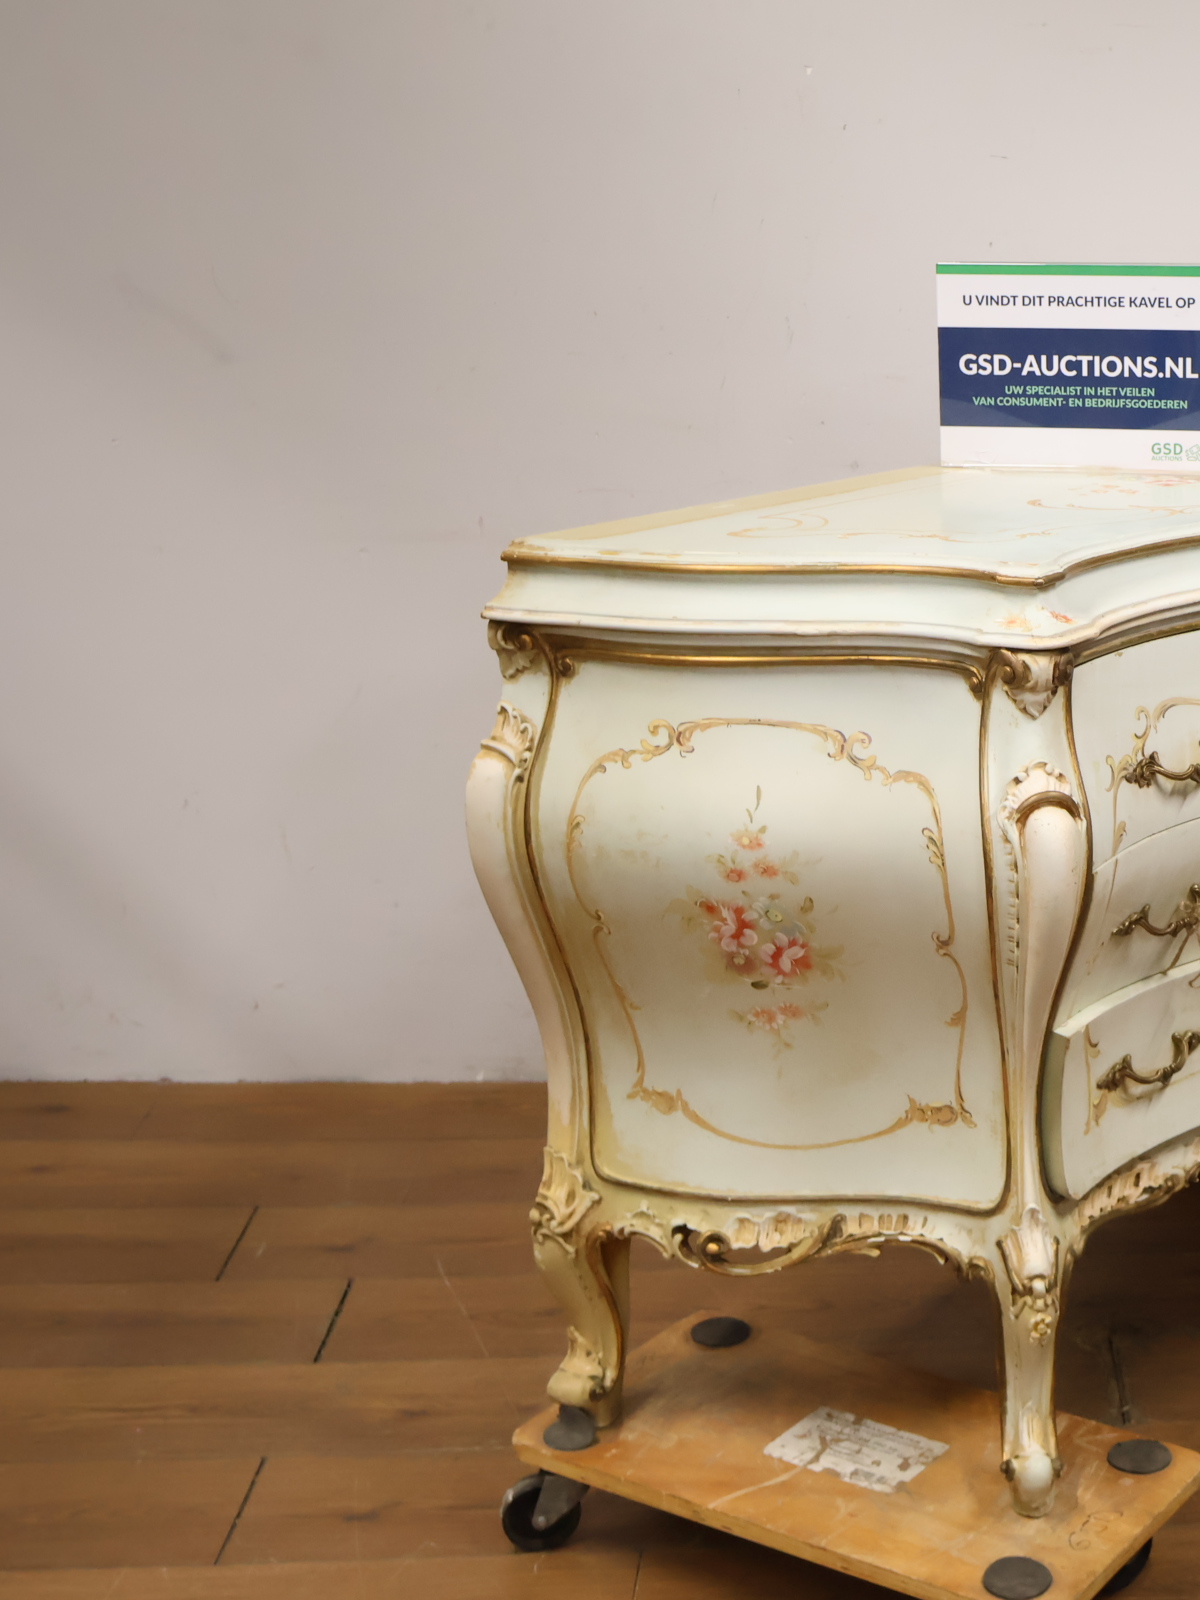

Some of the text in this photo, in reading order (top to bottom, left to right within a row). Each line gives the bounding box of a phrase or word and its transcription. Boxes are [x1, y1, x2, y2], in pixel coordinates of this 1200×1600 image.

[962, 295, 1196, 308] U VINDT DIT PRACHTIGE KAVEL OP
[958, 354, 1199, 379] GSD-AUCTIONS.NL
[1005, 385, 1155, 397] UW SPECIALIST IN HET VEILEN
[972, 396, 1188, 409] VAN CONSUMENT- EN BEDRIJFSGOEDEREN
[1151, 442, 1183, 455] GSD
